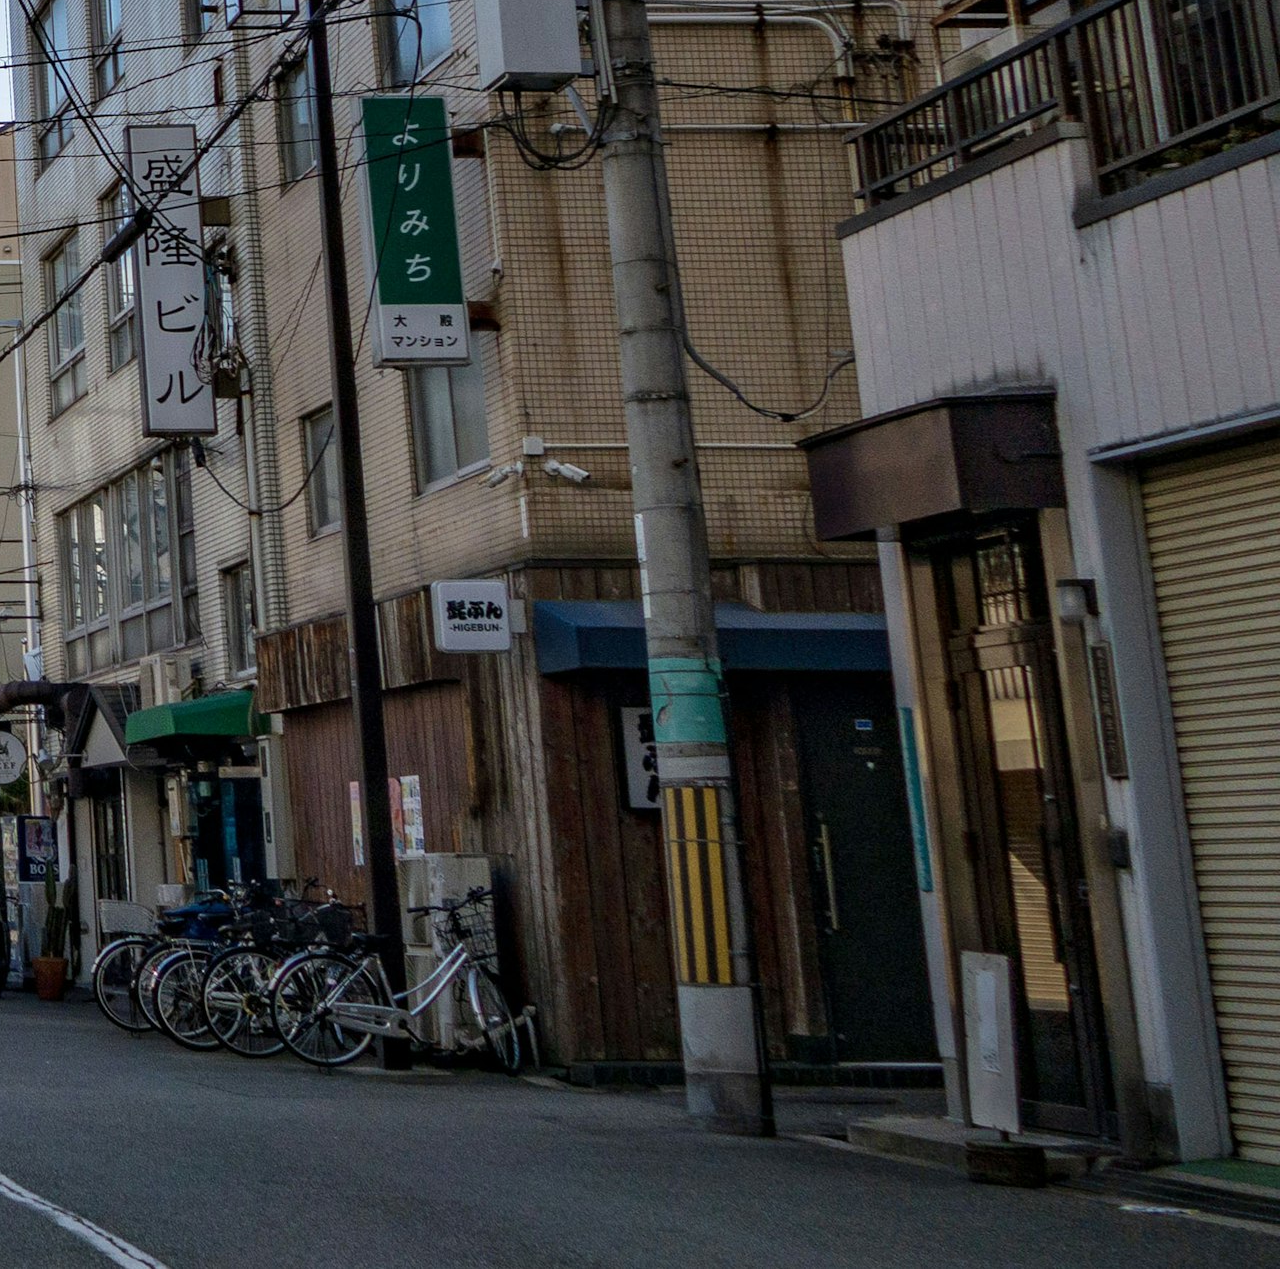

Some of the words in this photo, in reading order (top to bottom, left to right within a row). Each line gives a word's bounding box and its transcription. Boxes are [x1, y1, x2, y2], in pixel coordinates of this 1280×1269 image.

[392, 118, 432, 284] よりみち
[141, 153, 203, 405] 盛隆ビル
[391, 334, 459, 349] マンション
[30, 863, 60, 875] BOS
